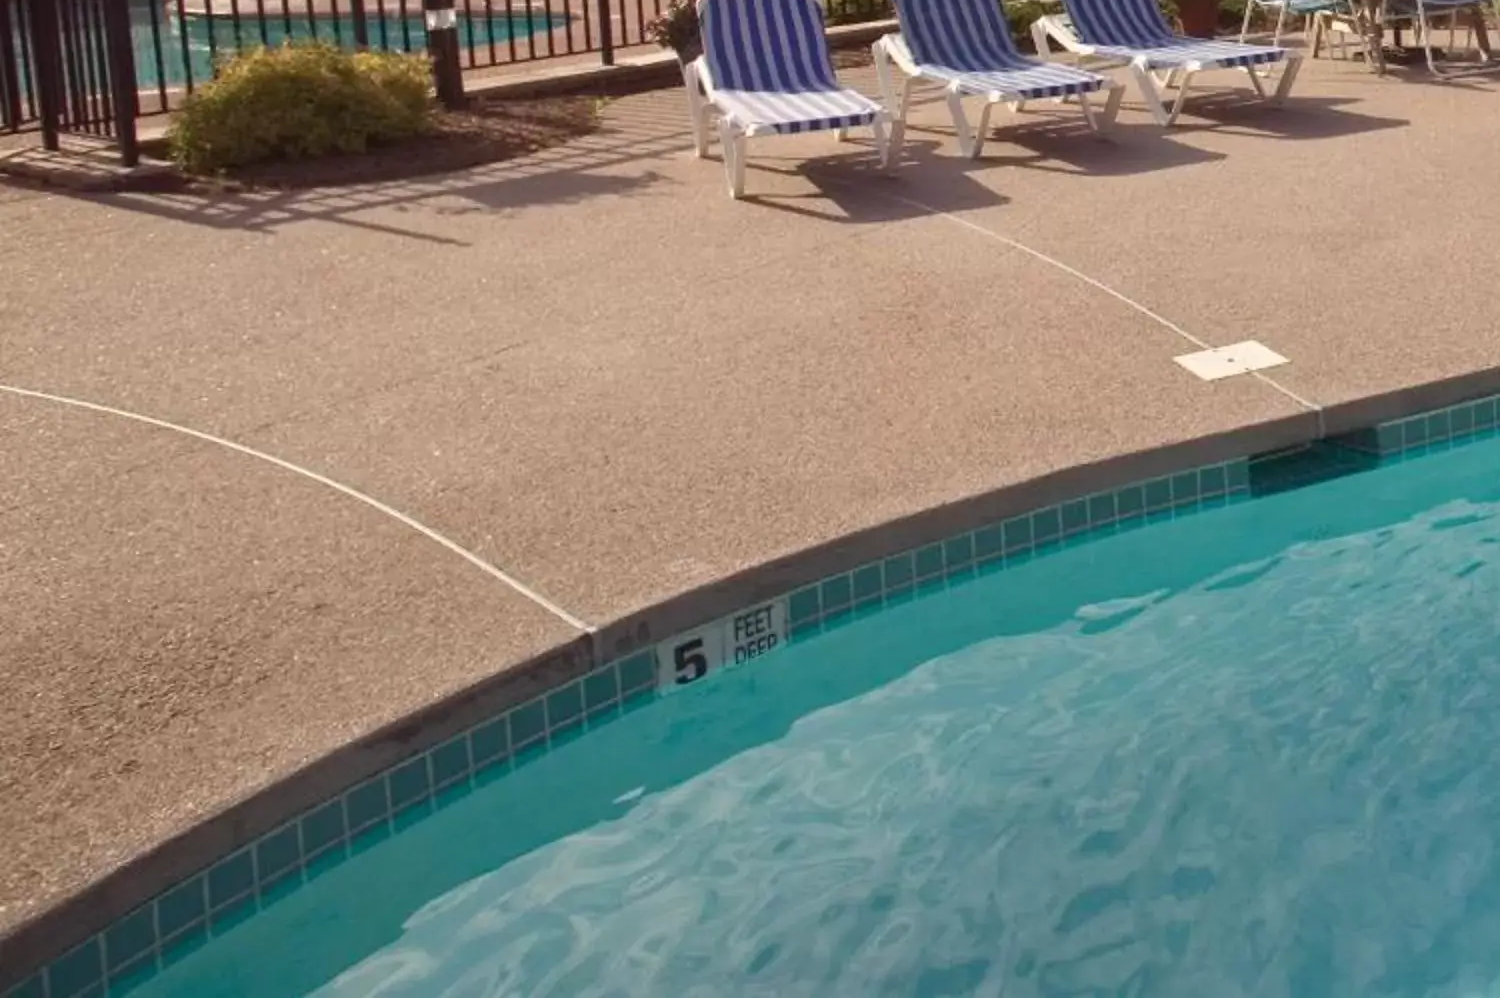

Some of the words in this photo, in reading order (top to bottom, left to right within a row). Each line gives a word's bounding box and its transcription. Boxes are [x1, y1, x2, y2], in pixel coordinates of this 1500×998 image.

[734, 604, 774, 641] FEET
[674, 638, 708, 684] 5
[734, 633, 777, 665] DEEP
